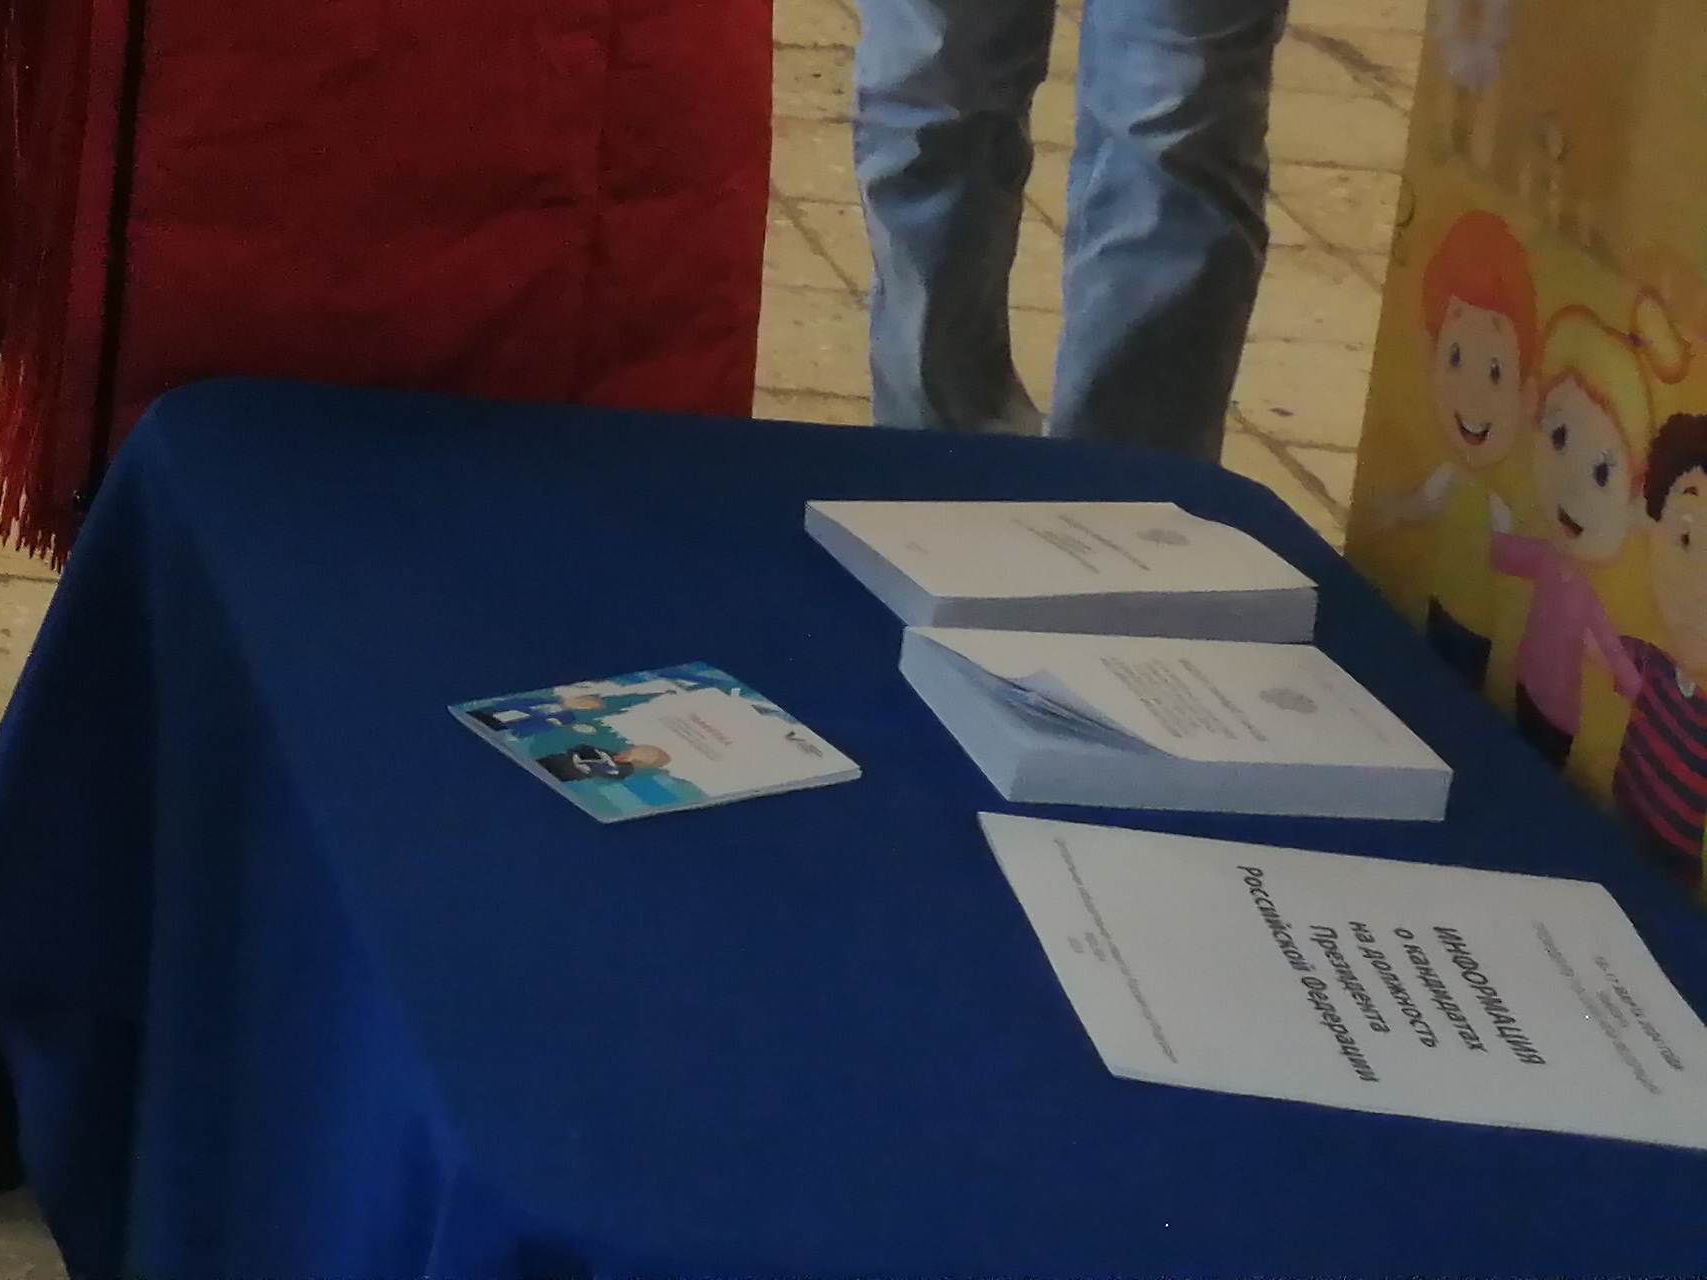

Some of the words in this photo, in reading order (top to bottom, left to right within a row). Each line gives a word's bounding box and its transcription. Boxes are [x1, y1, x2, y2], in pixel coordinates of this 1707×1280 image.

[1237, 864, 1316, 973] Российской
[1300, 975, 1380, 1083] Федерации
[1309, 924, 1390, 1034] Президента
[1348, 921, 1376, 944] на
[1393, 927, 1414, 940] о
[1358, 944, 1439, 1049] должность
[1403, 944, 1488, 1053] кандидатах
[1433, 925, 1546, 1065] ИНФОРМАЦИЯ
